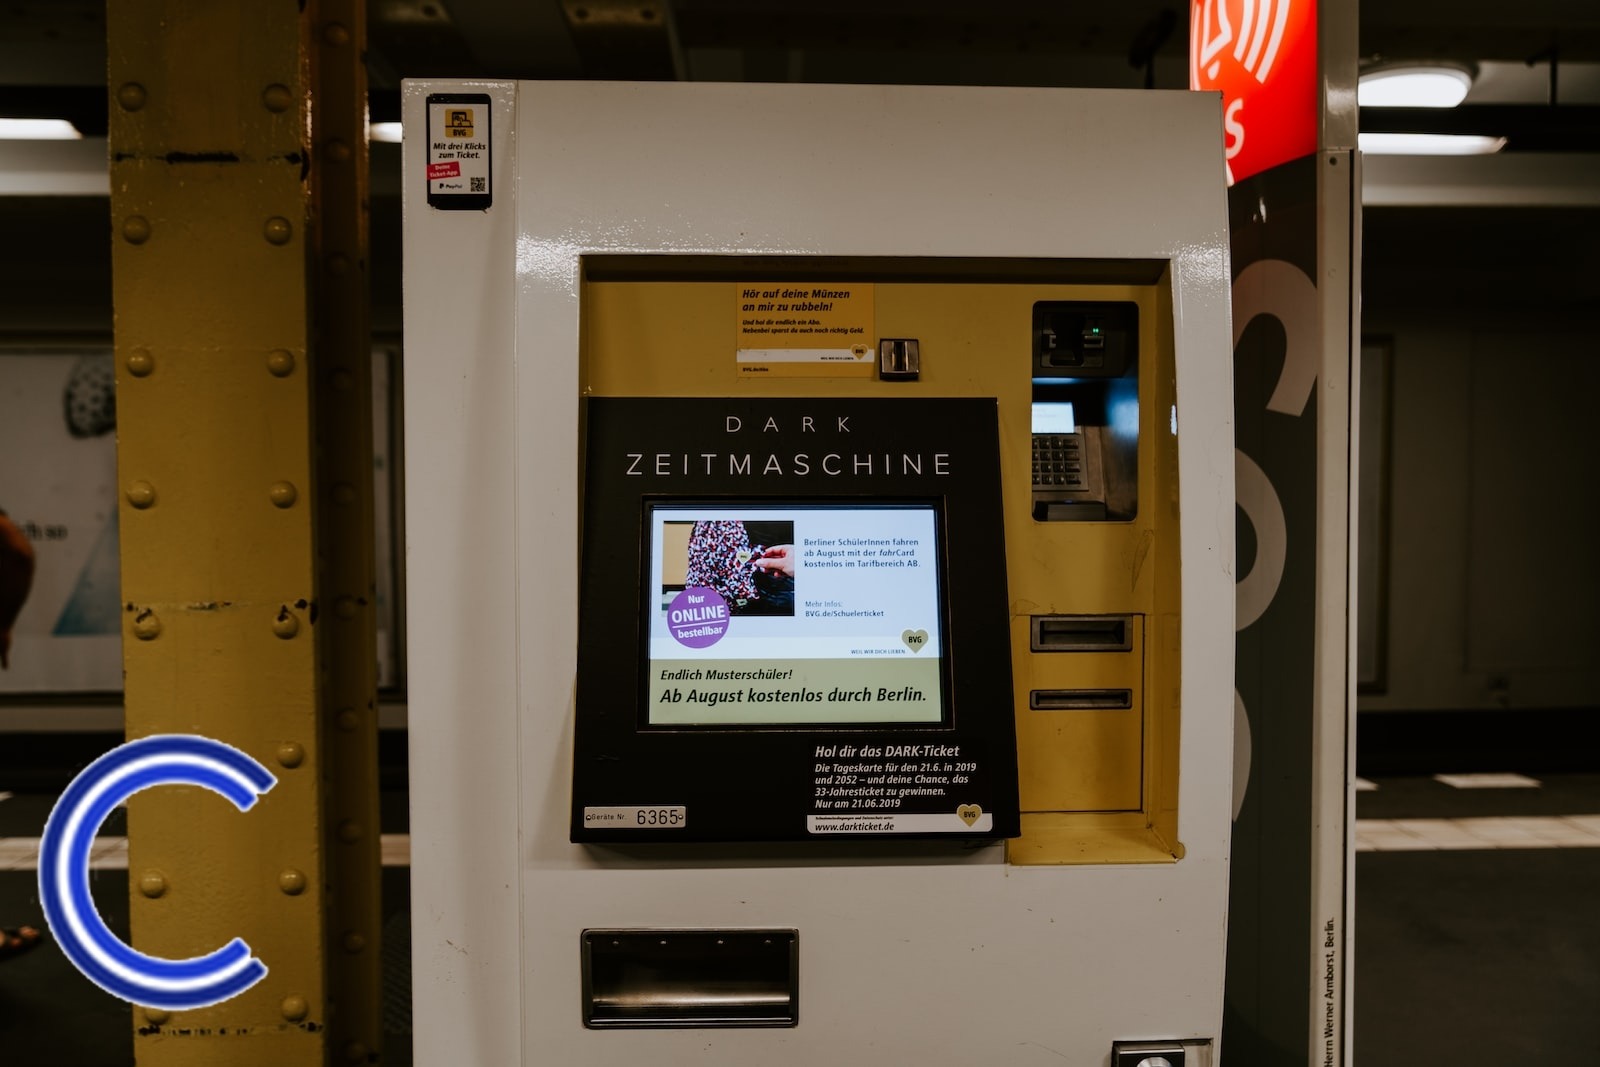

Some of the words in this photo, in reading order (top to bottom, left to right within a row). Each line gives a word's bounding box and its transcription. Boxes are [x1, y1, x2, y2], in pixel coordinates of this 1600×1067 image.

[742, 290, 760, 298] Hör
[762, 289, 780, 298] auf
[782, 289, 808, 298] deine
[812, 289, 850, 298] Münzen
[758, 302, 774, 311] mir
[791, 302, 832, 312] rubbeln!
[726, 416, 850, 432] DARK
[626, 454, 950, 475] ZEITMASCHINE
[804, 538, 835, 546] Berliner
[838, 538, 890, 546] SchülerInnen
[816, 550, 844, 558] August
[848, 549, 860, 557] mit
[863, 549, 876, 557] der
[878, 548, 914, 558] fahrCard
[688, 594, 704, 604] Nur
[672, 605, 726, 623] ONLINE
[678, 626, 723, 638] bestellbar
[660, 670, 702, 680] Endlich
[706, 670, 792, 680] Musterschüler!
[660, 689, 682, 703] Ab
[687, 688, 743, 706] August
[749, 688, 822, 702] kostenlos
[828, 688, 872, 702] durch
[877, 687, 926, 702] Berlin.
[815, 746, 836, 758] Hol
[840, 746, 857, 757] dir
[860, 746, 882, 757] das
[885, 746, 960, 757] DARK-Ticket
[815, 764, 830, 772] Die
[833, 764, 882, 774] Tageskarte
[885, 764, 899, 774] für
[901, 764, 918, 772] den
[920, 764, 942, 772] 21.6.
[944, 764, 952, 772] in
[954, 763, 976, 772] 2019
[815, 776, 832, 784] und
[835, 776, 857, 784] 2052
[867, 776, 884, 784] und
[887, 775, 912, 784] deine
[914, 775, 950, 785] Chance,
[952, 775, 968, 783] das
[815, 788, 884, 796] 33-Jahresticket
[899, 787, 946, 798] gewinnen.
[815, 800, 832, 808] Nur
[852, 800, 900, 808] 21.06.2019
[638, 810, 678, 824] 6365
[815, 822, 894, 830] www.darkticket.de
[1324, 917, 1334, 948] Berlin.
[1324, 951, 1335, 999] Armborst,
[1324, 1002, 1334, 1038] Werner
